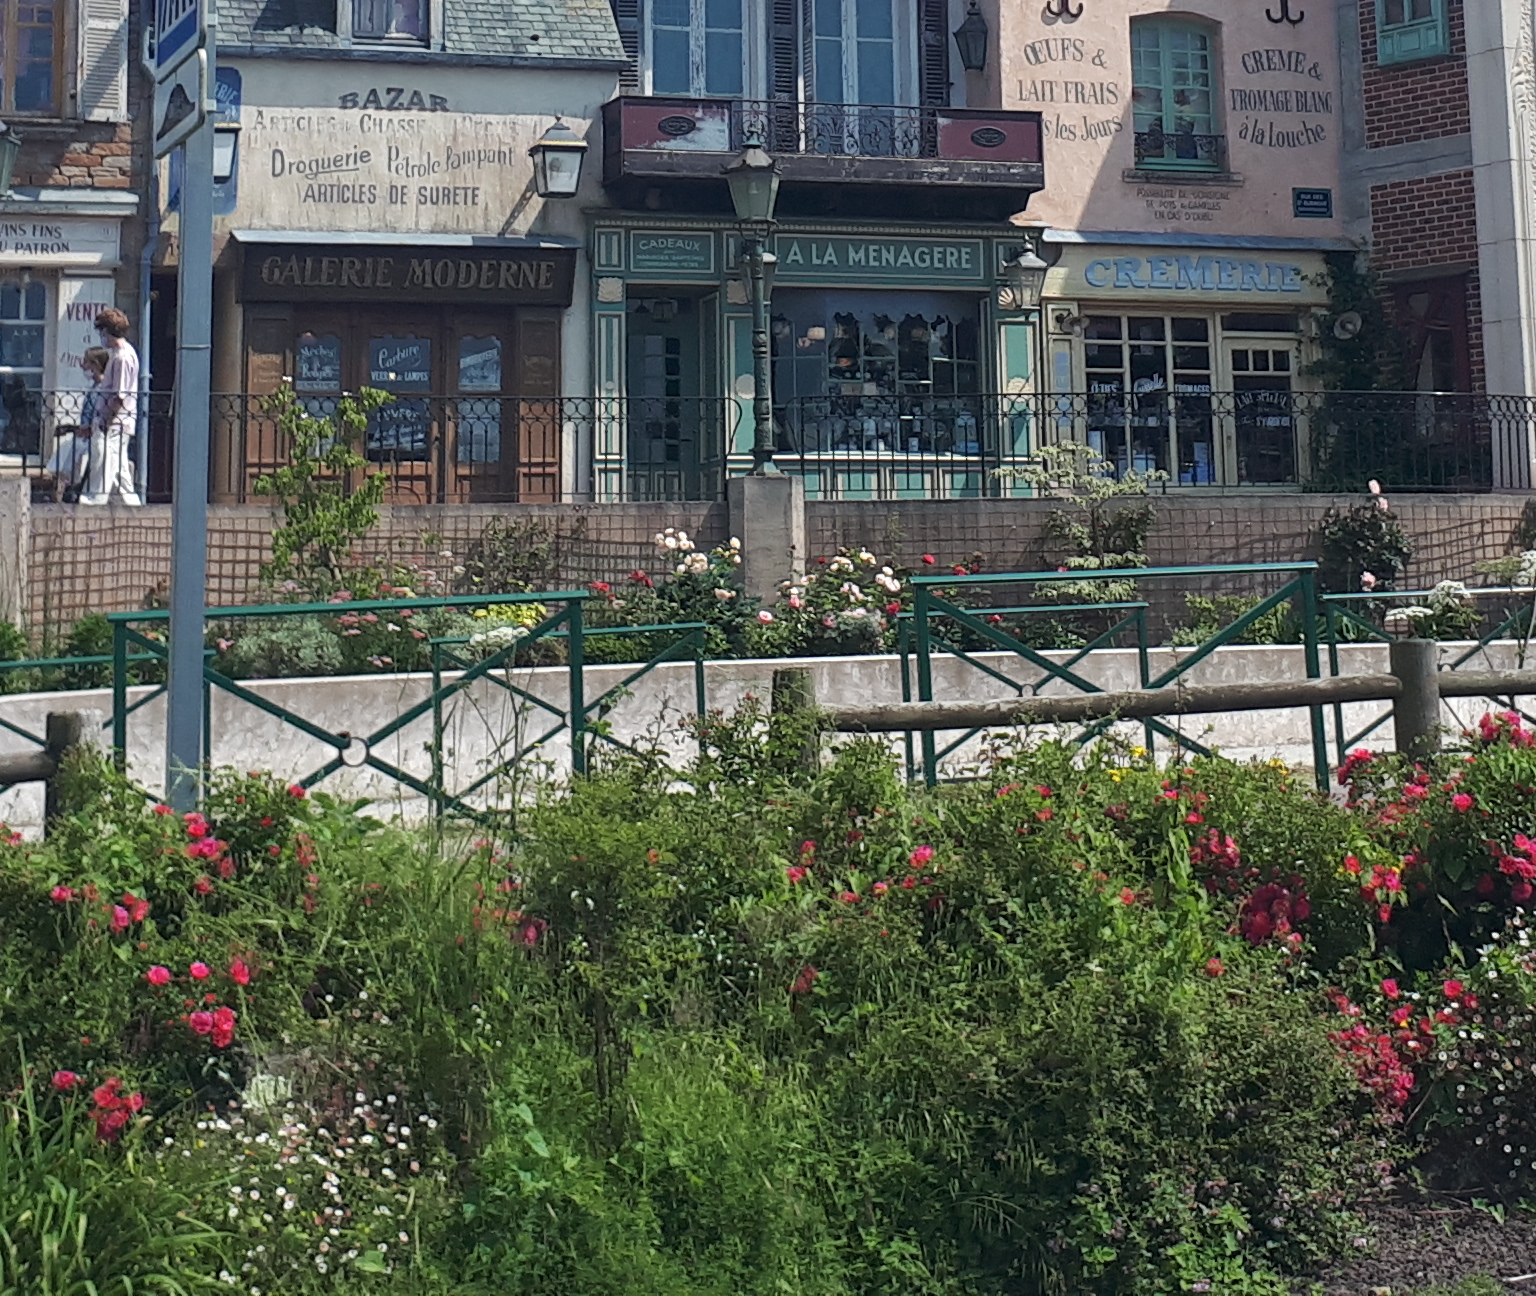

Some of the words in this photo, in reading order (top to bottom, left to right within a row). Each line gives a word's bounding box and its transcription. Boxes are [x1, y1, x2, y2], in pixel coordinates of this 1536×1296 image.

[338, 88, 451, 112] BAZAR
[1017, 80, 1057, 102] LAIT
[1063, 81, 1119, 105] FRAIS
[1230, 88, 1293, 113] FROMAGE
[1295, 90, 1333, 114] BLANC
[1055, 114, 1077, 141] les
[1081, 116, 1123, 141] Jours
[1250, 119, 1265, 145] la
[1268, 120, 1326, 148] Louche
[271, 145, 372, 179] Droguerie
[303, 184, 377, 204] ARTICLES
[390, 186, 408, 205] DE
[418, 186, 480, 206] SURETE
[31, 223, 63, 239] FINS
[14, 241, 70, 255] PATRON
[639, 238, 701, 252] CADEAUX
[786, 240, 803, 264] A
[811, 242, 839, 265] LA
[848, 244, 972, 269] MENAGERE
[261, 254, 394, 288] GALERIE
[404, 257, 555, 290] MODERNE
[1084, 255, 1301, 292] CREMERIE
